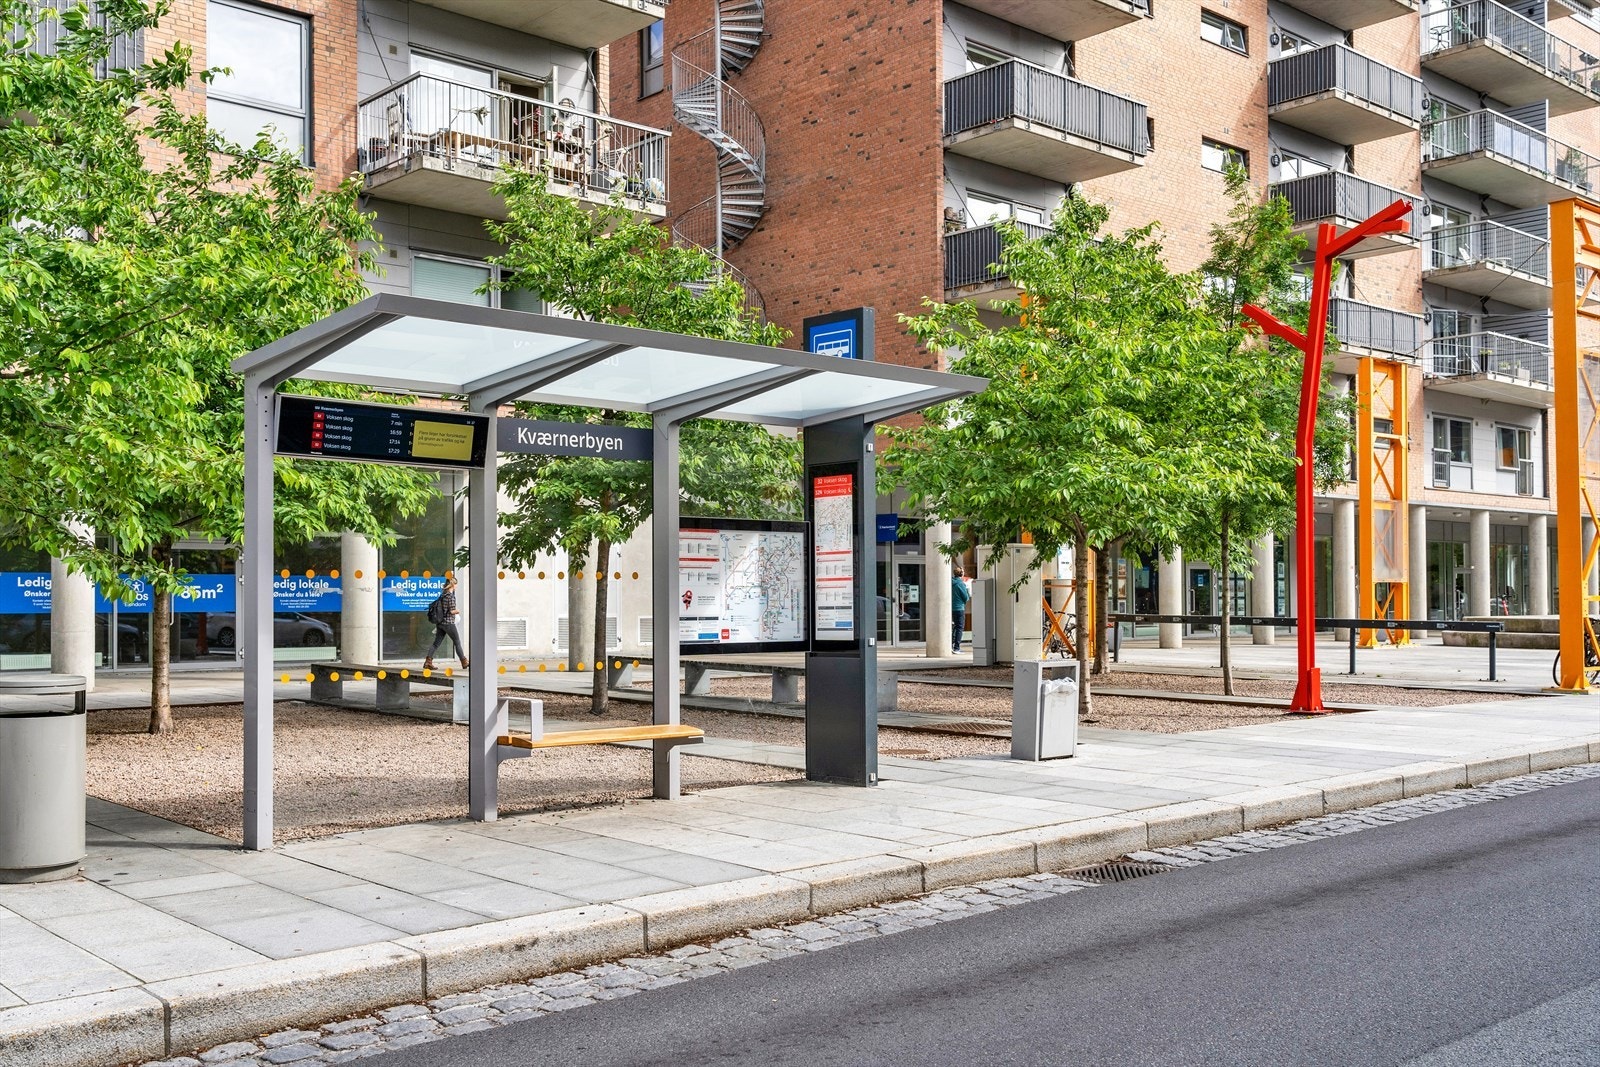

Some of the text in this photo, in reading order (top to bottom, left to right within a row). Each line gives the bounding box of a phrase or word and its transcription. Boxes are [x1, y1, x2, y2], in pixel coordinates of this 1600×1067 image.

[517, 427, 623, 453] Kværnerbyen
[17, 576, 52, 590] Ledig
[274, 579, 330, 591] edig lokale
[391, 580, 416, 591] Ledig
